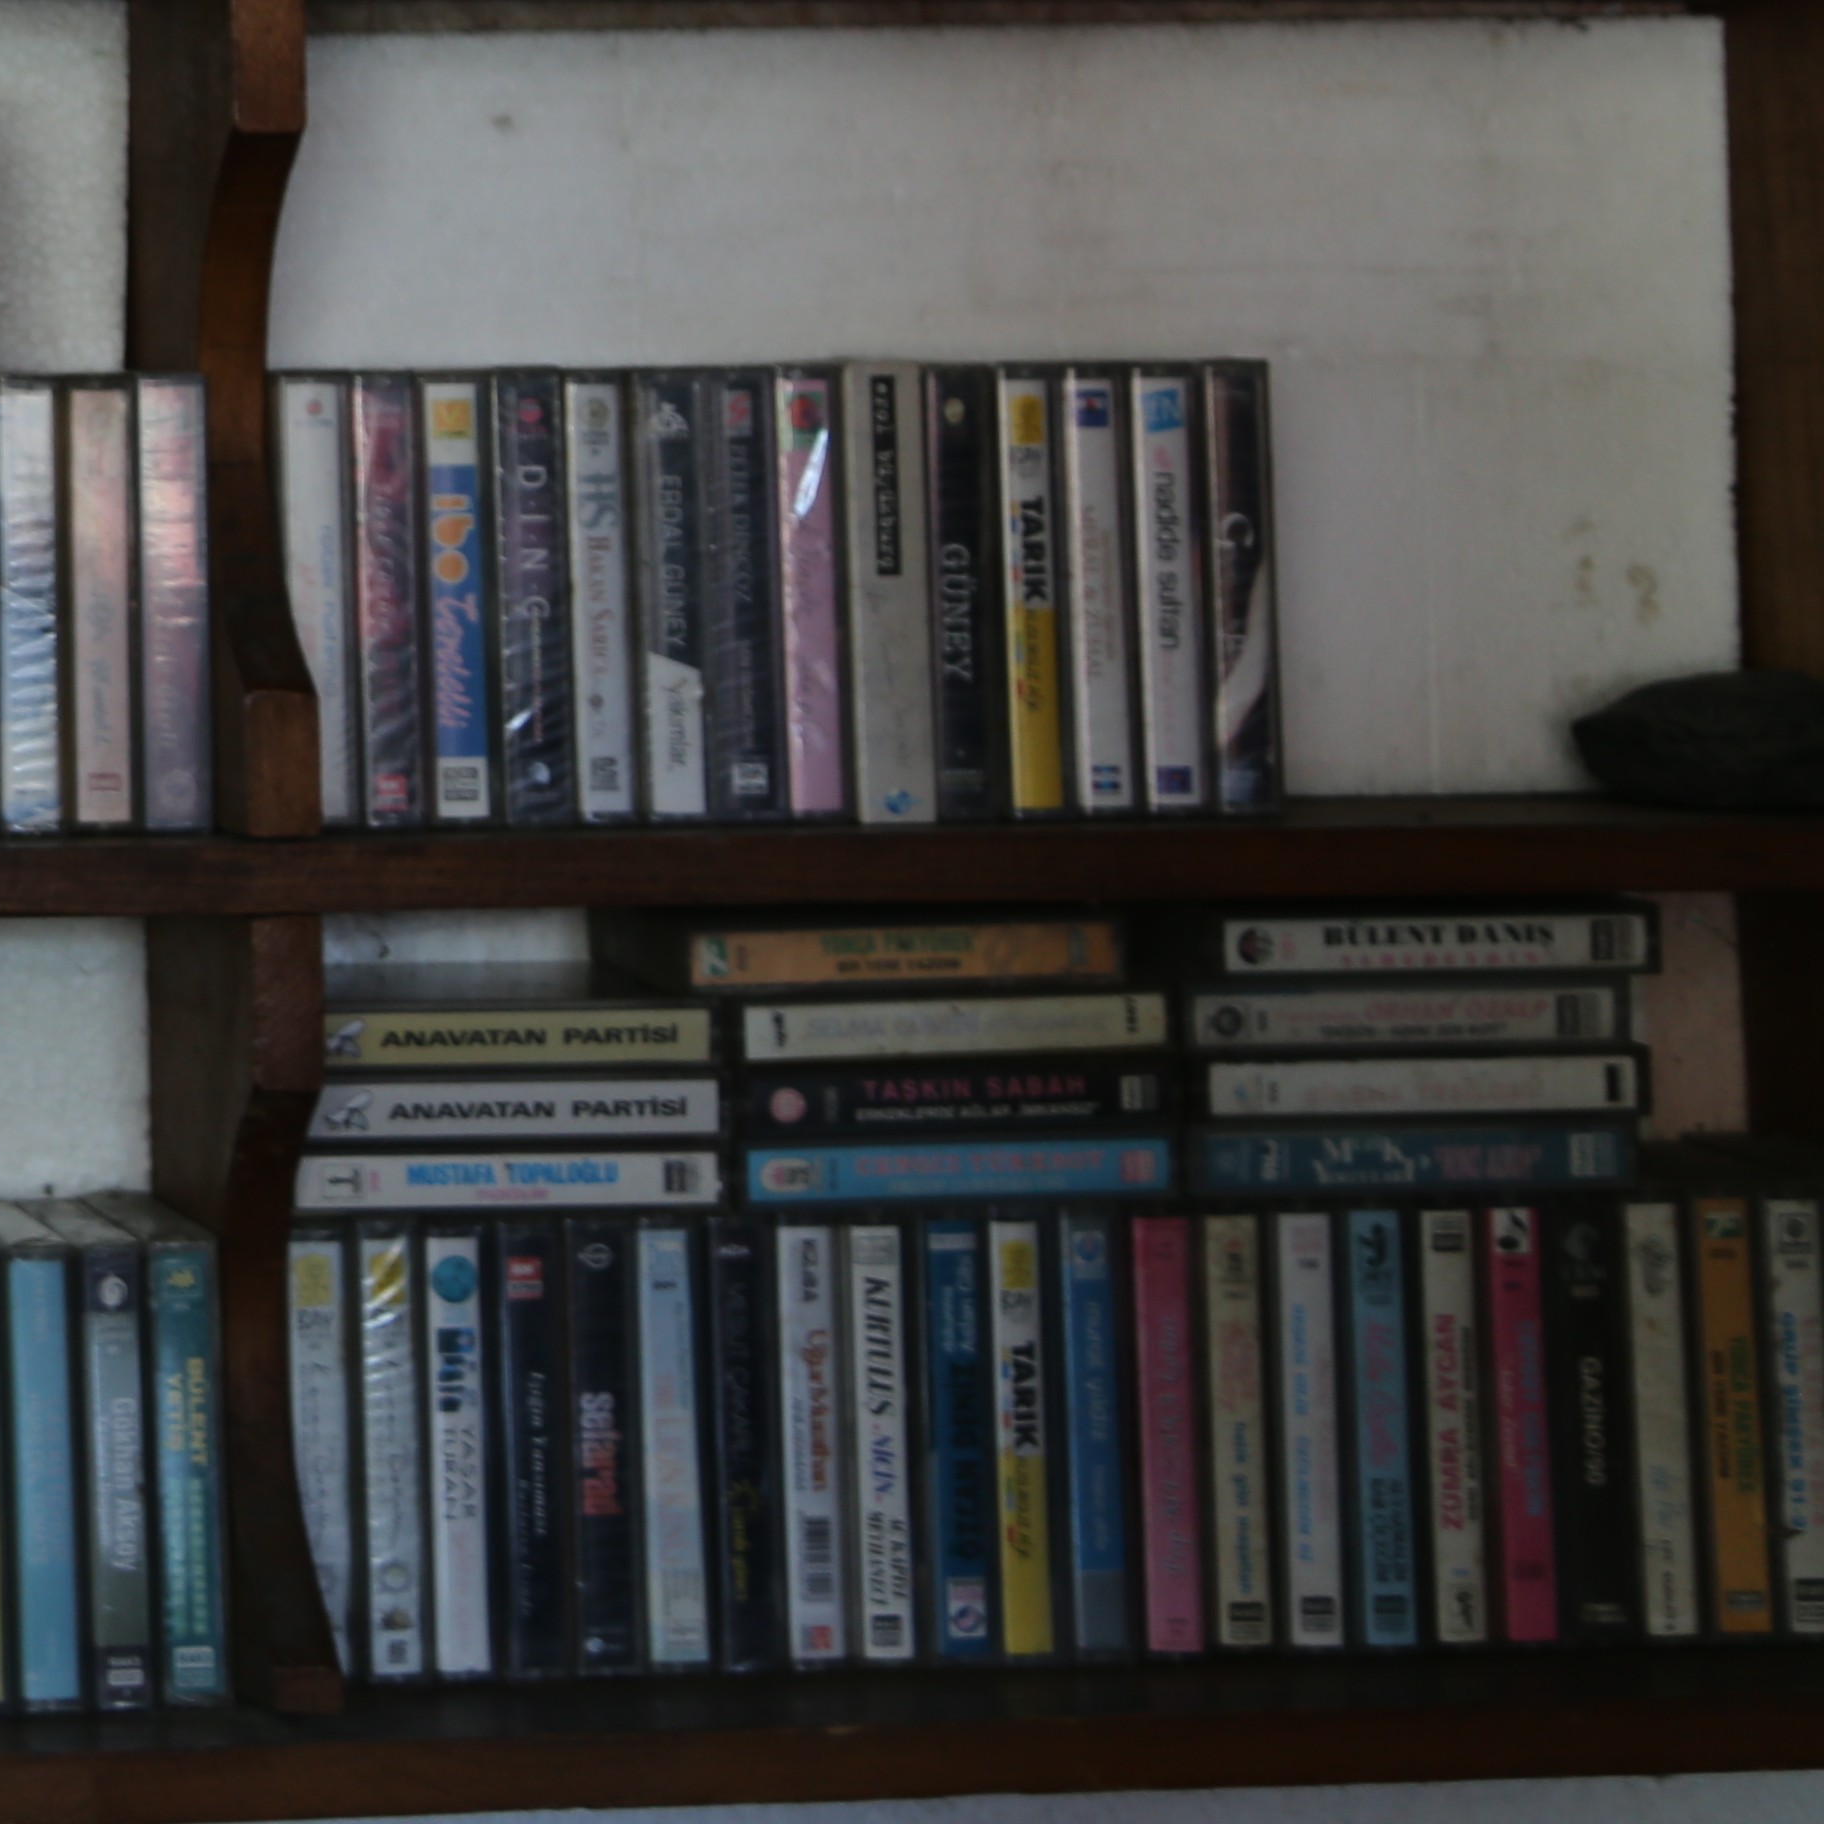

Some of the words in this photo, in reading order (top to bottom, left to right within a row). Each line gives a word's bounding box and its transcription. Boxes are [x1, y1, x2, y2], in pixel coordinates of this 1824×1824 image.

[432, 494, 474, 584] ibo
[661, 476, 682, 552] ERDAL
[1022, 496, 1047, 603] TARIK
[1155, 472, 1181, 561] nadide
[587, 537, 610, 602] HAKAN
[664, 564, 686, 649] GÜNEY
[1159, 572, 1184, 651] sultan
[939, 542, 976, 684] GÜNEY
[1323, 921, 1445, 947] BÜLENT
[380, 1028, 547, 1048] ANAVATAN
[563, 1023, 678, 1045] PARTİSİ
[388, 1100, 555, 1121] ANAVATAN
[572, 1095, 686, 1118] PARTİSİ
[862, 1076, 970, 1103] TAŞKIN
[987, 1075, 1087, 1096] SABAH
[406, 1163, 496, 1186] MUSTAFA
[506, 1158, 619, 1185] TOPALOĞLU
[860, 1276, 893, 1418] KURTULUŞ
[186, 1358, 210, 1467] BÜLENT
[1012, 1339, 1039, 1451] TARIK
[110, 1397, 138, 1490] Gökhan
[580, 1391, 623, 1516] sefarad
[111, 1498, 140, 1571] Aksoy
